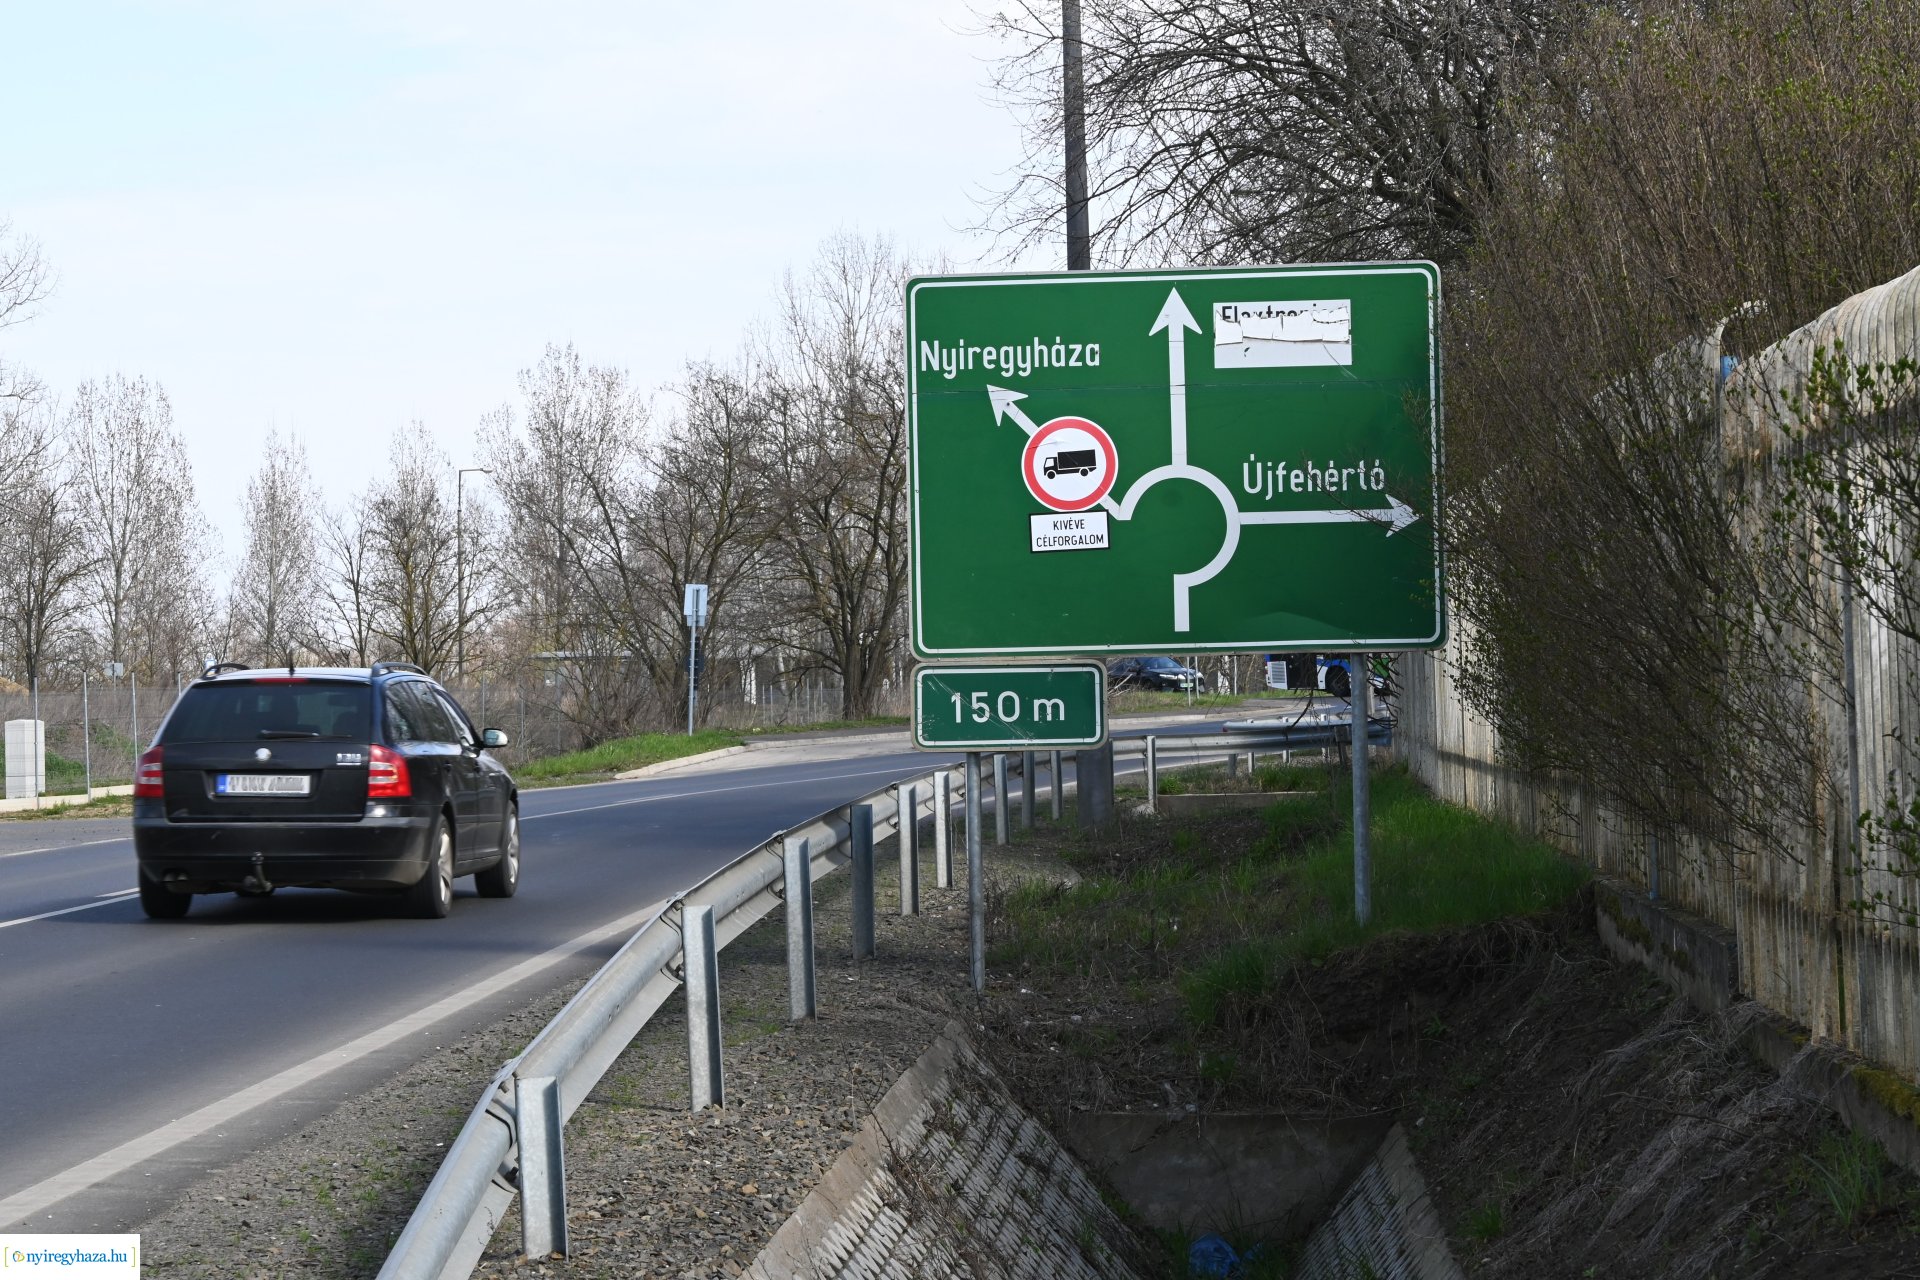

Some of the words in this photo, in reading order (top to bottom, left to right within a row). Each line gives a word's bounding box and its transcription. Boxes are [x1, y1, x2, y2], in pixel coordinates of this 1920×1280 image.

[1242, 453, 1386, 501] Újfehértó
[1052, 516, 1086, 531] KIVÉVE
[1036, 533, 1105, 548] CÉLFORGALOM
[951, 690, 1020, 723] 150
[1033, 698, 1065, 722] m
